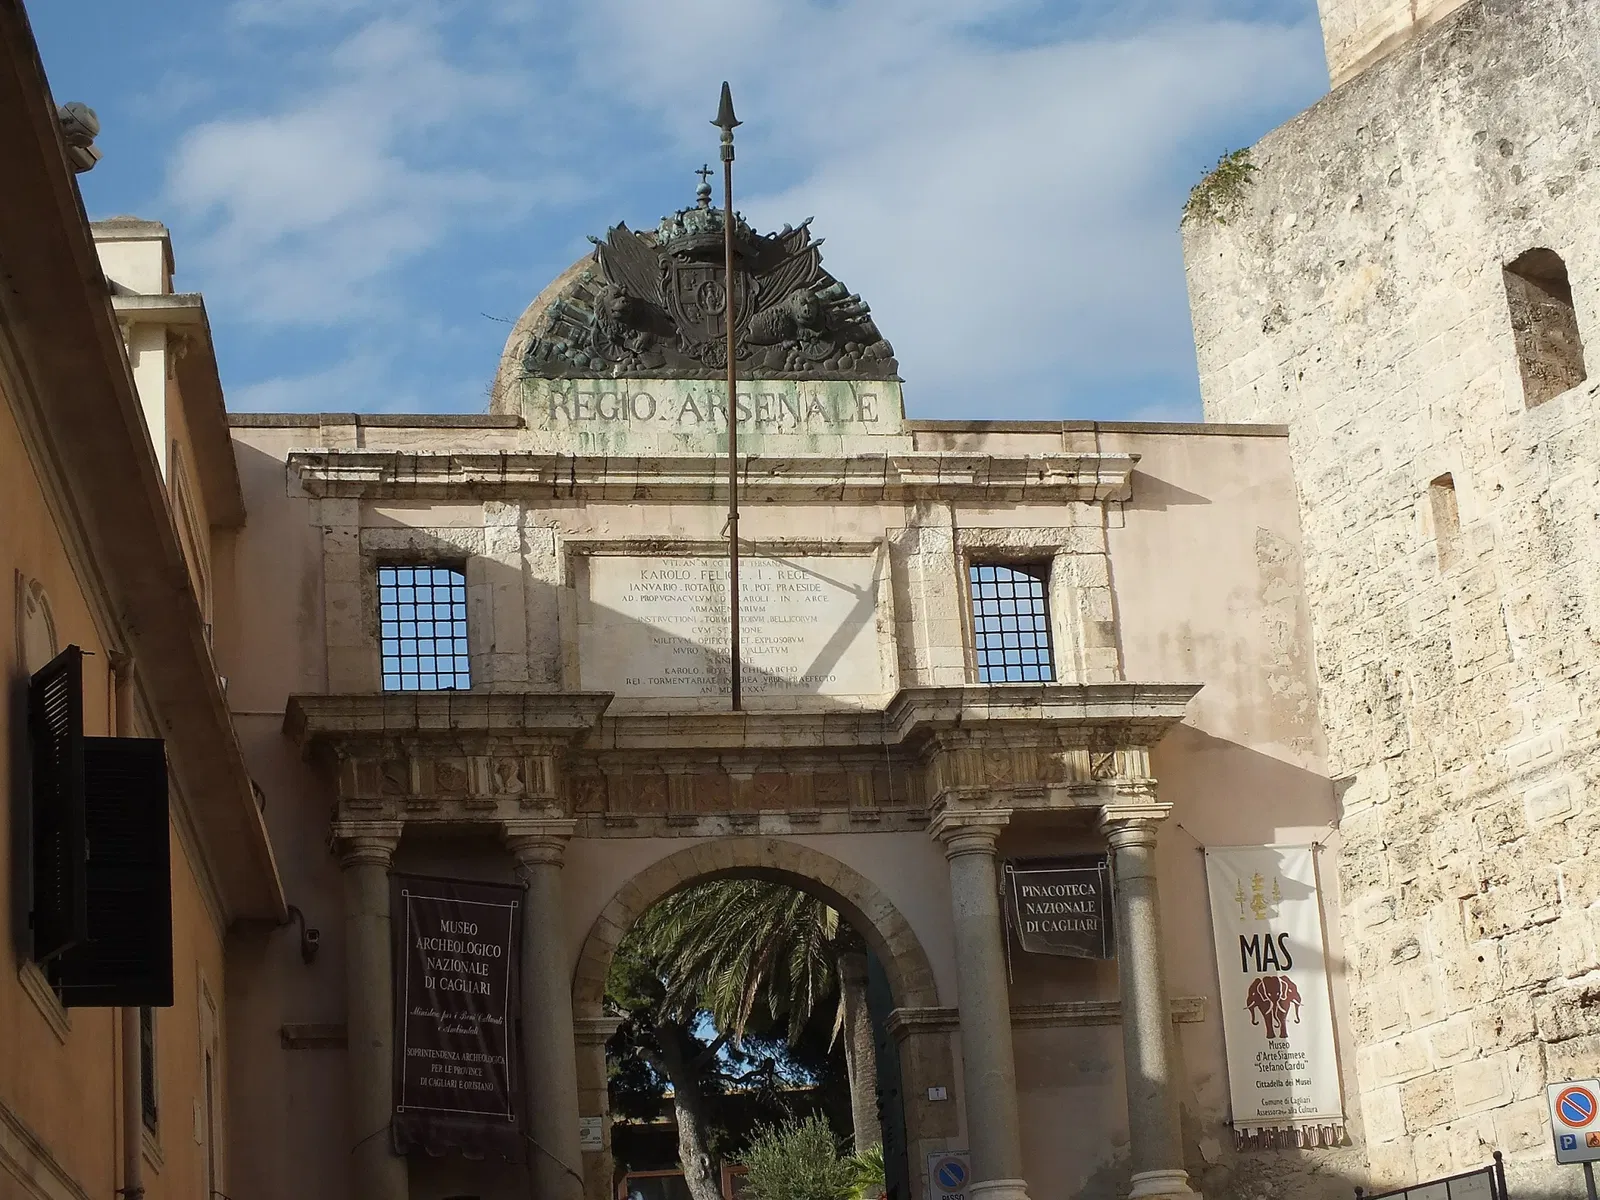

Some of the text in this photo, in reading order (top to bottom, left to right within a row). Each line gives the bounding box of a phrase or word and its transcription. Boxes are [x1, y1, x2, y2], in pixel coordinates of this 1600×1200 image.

[676, 392, 879, 423] ARSENALE
[640, 570, 691, 580] KAROLO
[777, 570, 810, 580] REGE
[629, 583, 677, 592] IANVARIO
[684, 583, 725, 593] ROTARIO
[776, 584, 821, 592] PRAESIDE
[804, 595, 830, 603] ARCE
[672, 647, 699, 655] MVRO
[664, 667, 699, 675] KAROLO
[1021, 883, 1097, 897] PINACOTECA
[1026, 900, 1096, 915] NAZIONALE
[440, 920, 479, 936] MUSEO
[1026, 918, 1098, 933] DI CAGLIARI
[416, 937, 502, 958] ARCHEOLOGICO
[1239, 932, 1293, 972] MAS
[426, 957, 490, 976] NAZIONALE
[424, 975, 491, 995] DI CAGLIARI
[1268, 1040, 1291, 1050] Museo
[1277, 1050, 1306, 1060] Siamese
[431, 1063, 443, 1073] PER
[428, 1078, 457, 1089] CAGLIARI
[1256, 1077, 1312, 1089] Cittadella dei Musei
[1261, 1097, 1283, 1107] Comune
